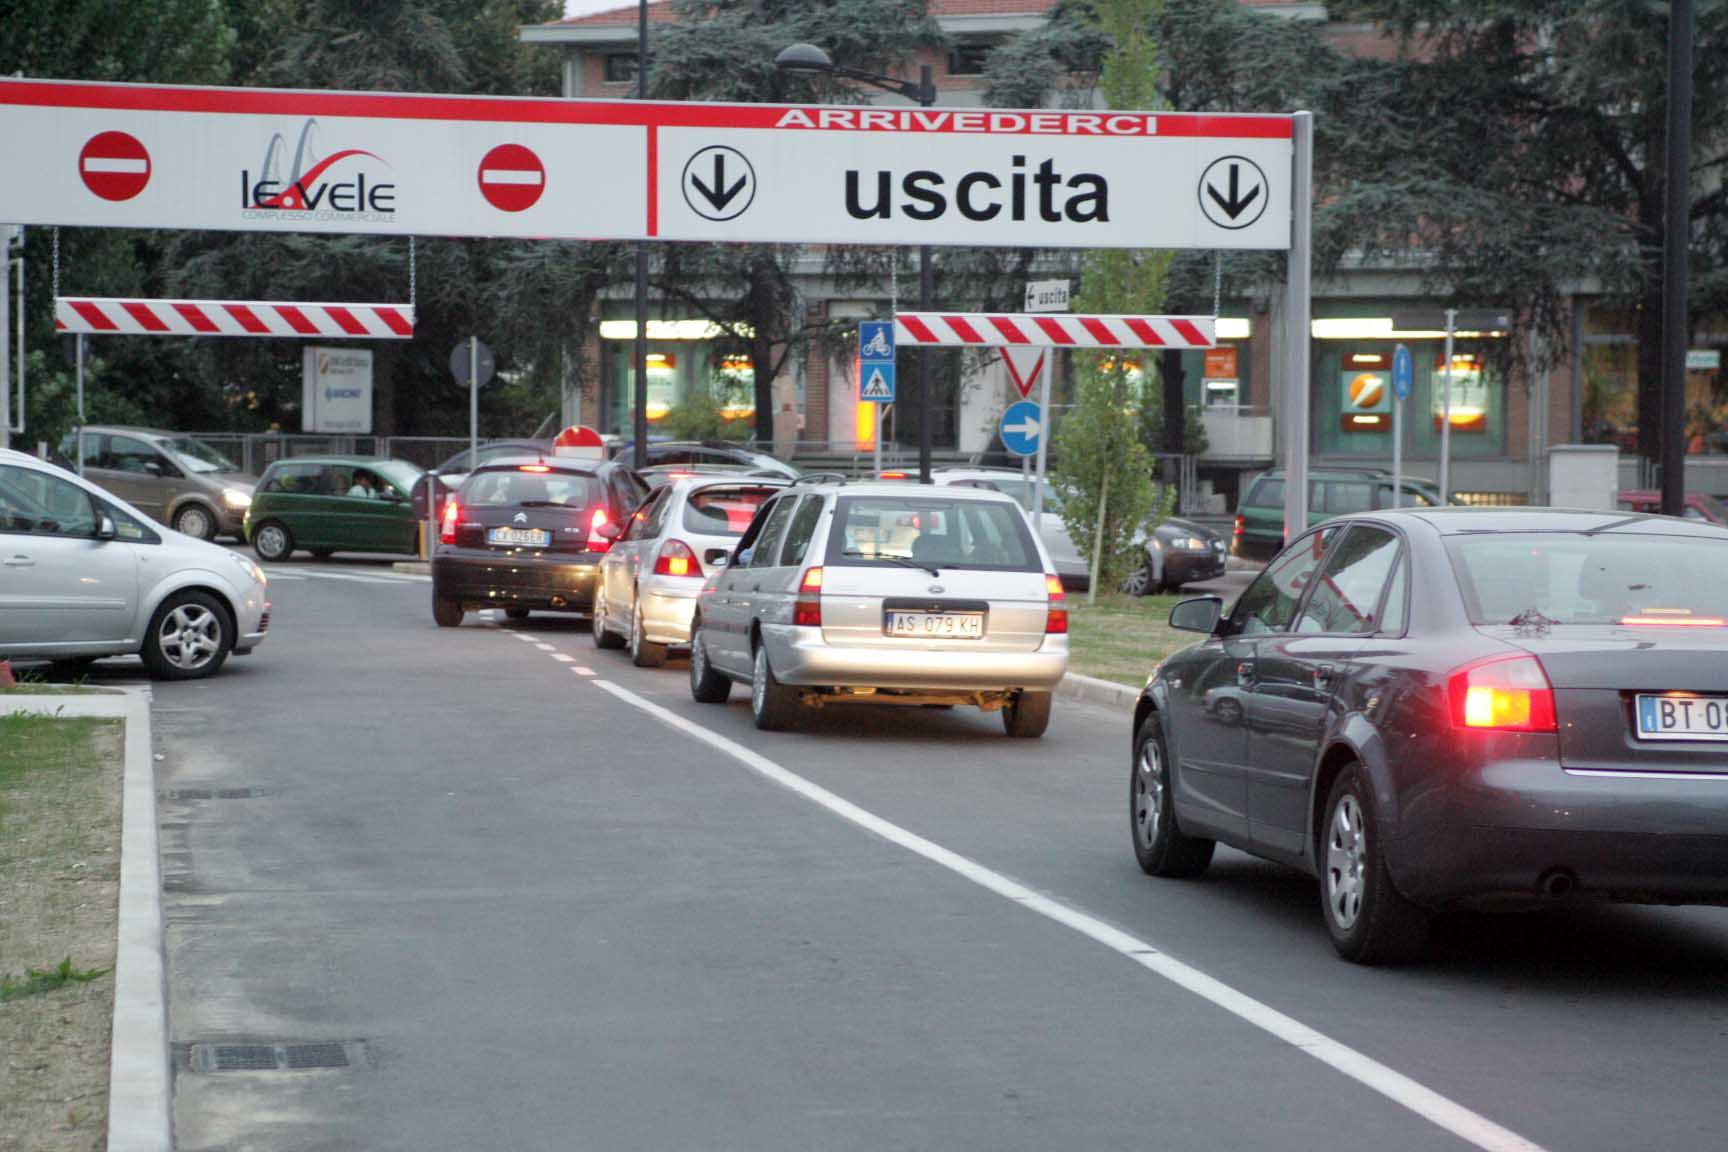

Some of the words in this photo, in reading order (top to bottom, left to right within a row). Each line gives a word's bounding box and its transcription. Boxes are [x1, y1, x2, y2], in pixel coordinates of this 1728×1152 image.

[775, 108, 1158, 135] ARRIVEDERCI
[845, 155, 1110, 223] uscita
[1039, 288, 1067, 304] uscita
[896, 615, 914, 632] AS
[924, 616, 953, 633] 079
[959, 618, 978, 633] KH
[1660, 700, 1694, 729] BT
